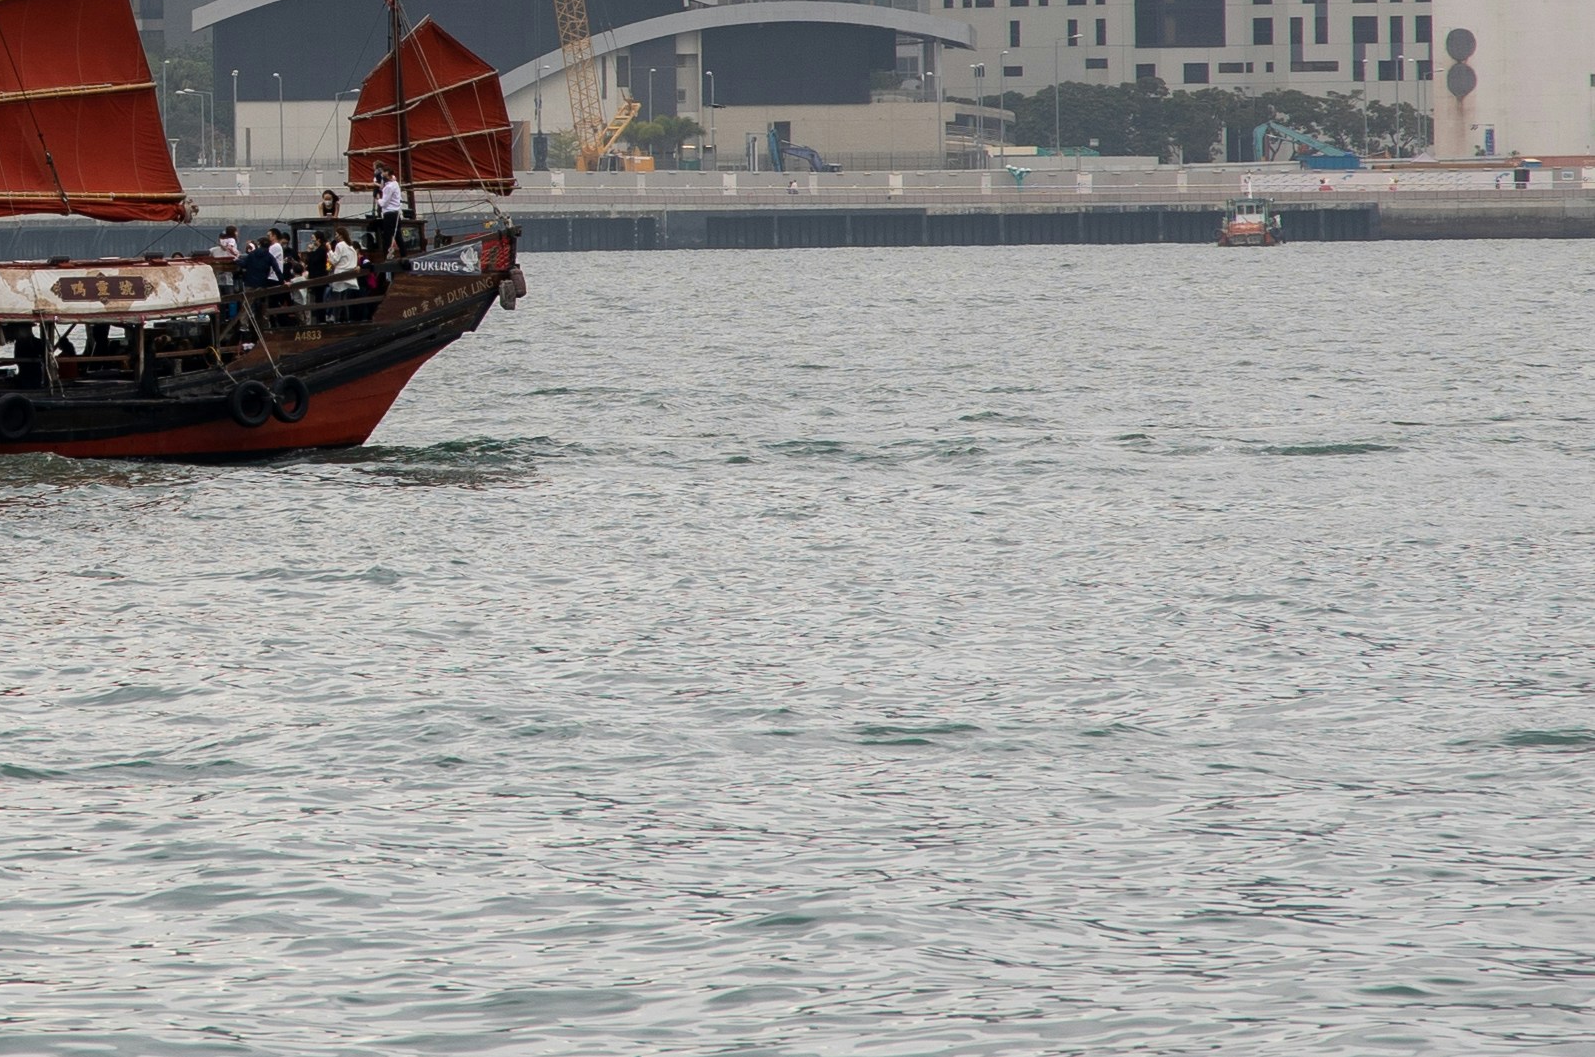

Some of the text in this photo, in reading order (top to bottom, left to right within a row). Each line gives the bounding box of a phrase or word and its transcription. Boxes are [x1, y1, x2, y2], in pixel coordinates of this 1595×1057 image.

[413, 260, 459, 272] DUKLING
[446, 286, 469, 304] DUK
[471, 277, 494, 294] LING
